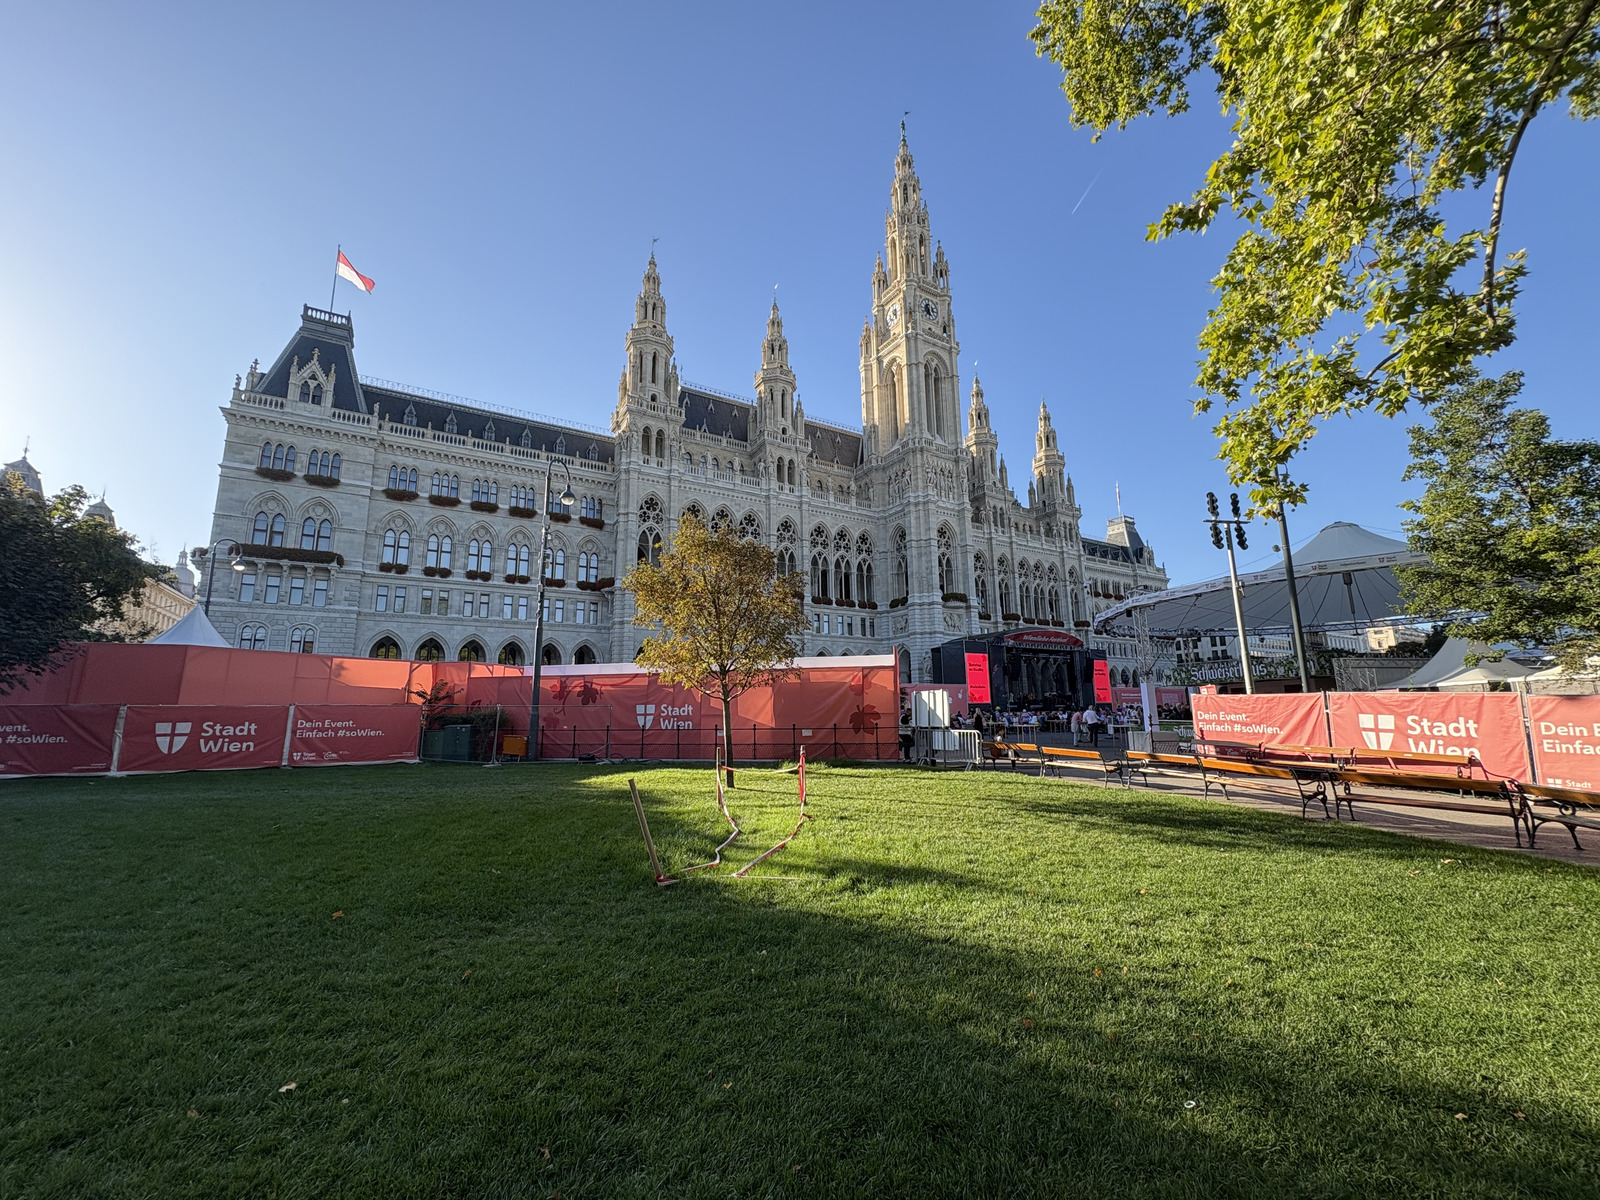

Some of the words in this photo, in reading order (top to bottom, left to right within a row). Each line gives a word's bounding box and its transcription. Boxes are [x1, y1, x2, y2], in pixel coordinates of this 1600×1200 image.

[1190, 662, 1267, 681] Schweizerus
[660, 703, 693, 716] Stadt
[1197, 711, 1218, 720] Dein
[1219, 711, 1250, 722] Event.
[0, 724, 31, 732] vent.
[201, 721, 258, 736] Stadt
[297, 719, 322, 728] Dein
[324, 719, 356, 728] Event.
[660, 718, 693, 730] Wien
[1198, 722, 1232, 732] Einfach
[1233, 723, 1284, 735] #soWien.
[1406, 715, 1479, 738] Stadt
[1540, 722, 1588, 737] Dein
[5, 734, 68, 744] #soWien.
[296, 729, 335, 738] Einfach
[337, 729, 385, 738] #soWien.
[199, 738, 255, 753] Wien
[1408, 737, 1481, 758] Wien
[1566, 779, 1592, 789] Stadt
